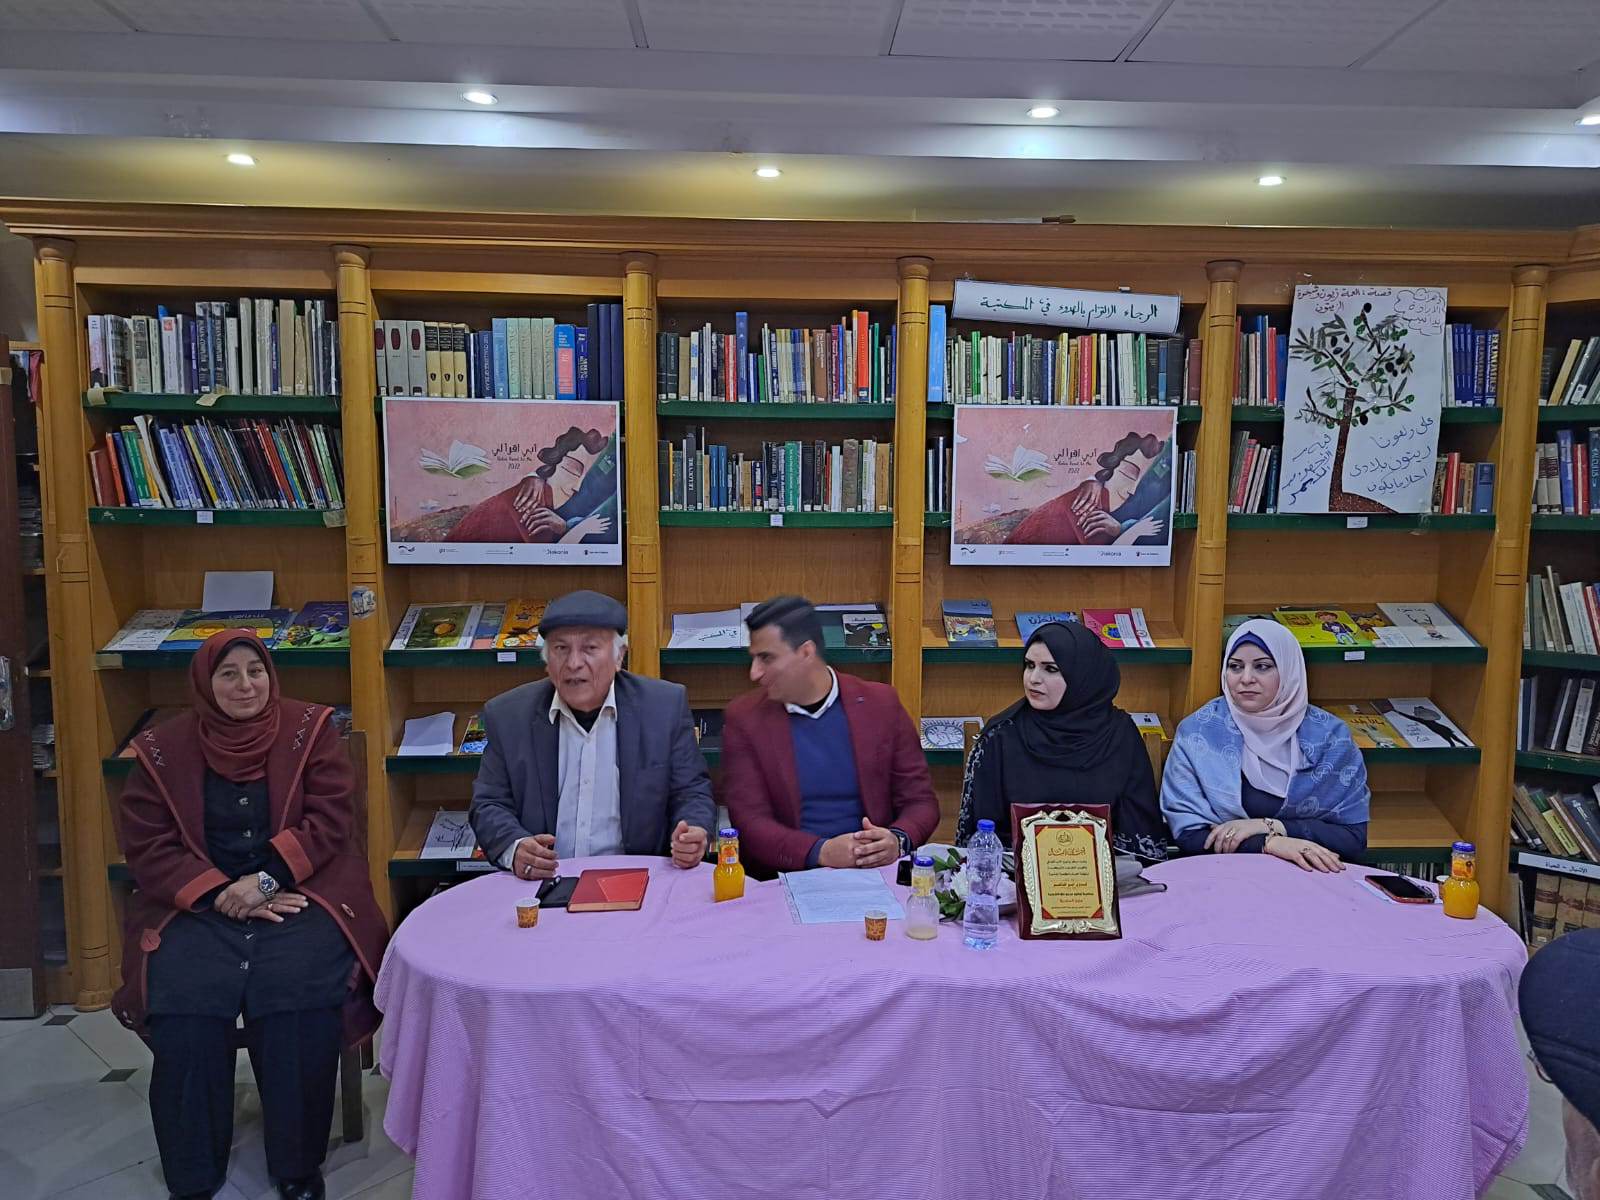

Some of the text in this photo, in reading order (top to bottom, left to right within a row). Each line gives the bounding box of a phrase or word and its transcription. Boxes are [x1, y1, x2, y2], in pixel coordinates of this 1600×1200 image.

[979, 296, 1033, 313] المكتبة
[1039, 298, 1051, 316] في
[1124, 303, 1158, 323] الرجاء
[1489, 334, 1499, 393] ECONOMICS
